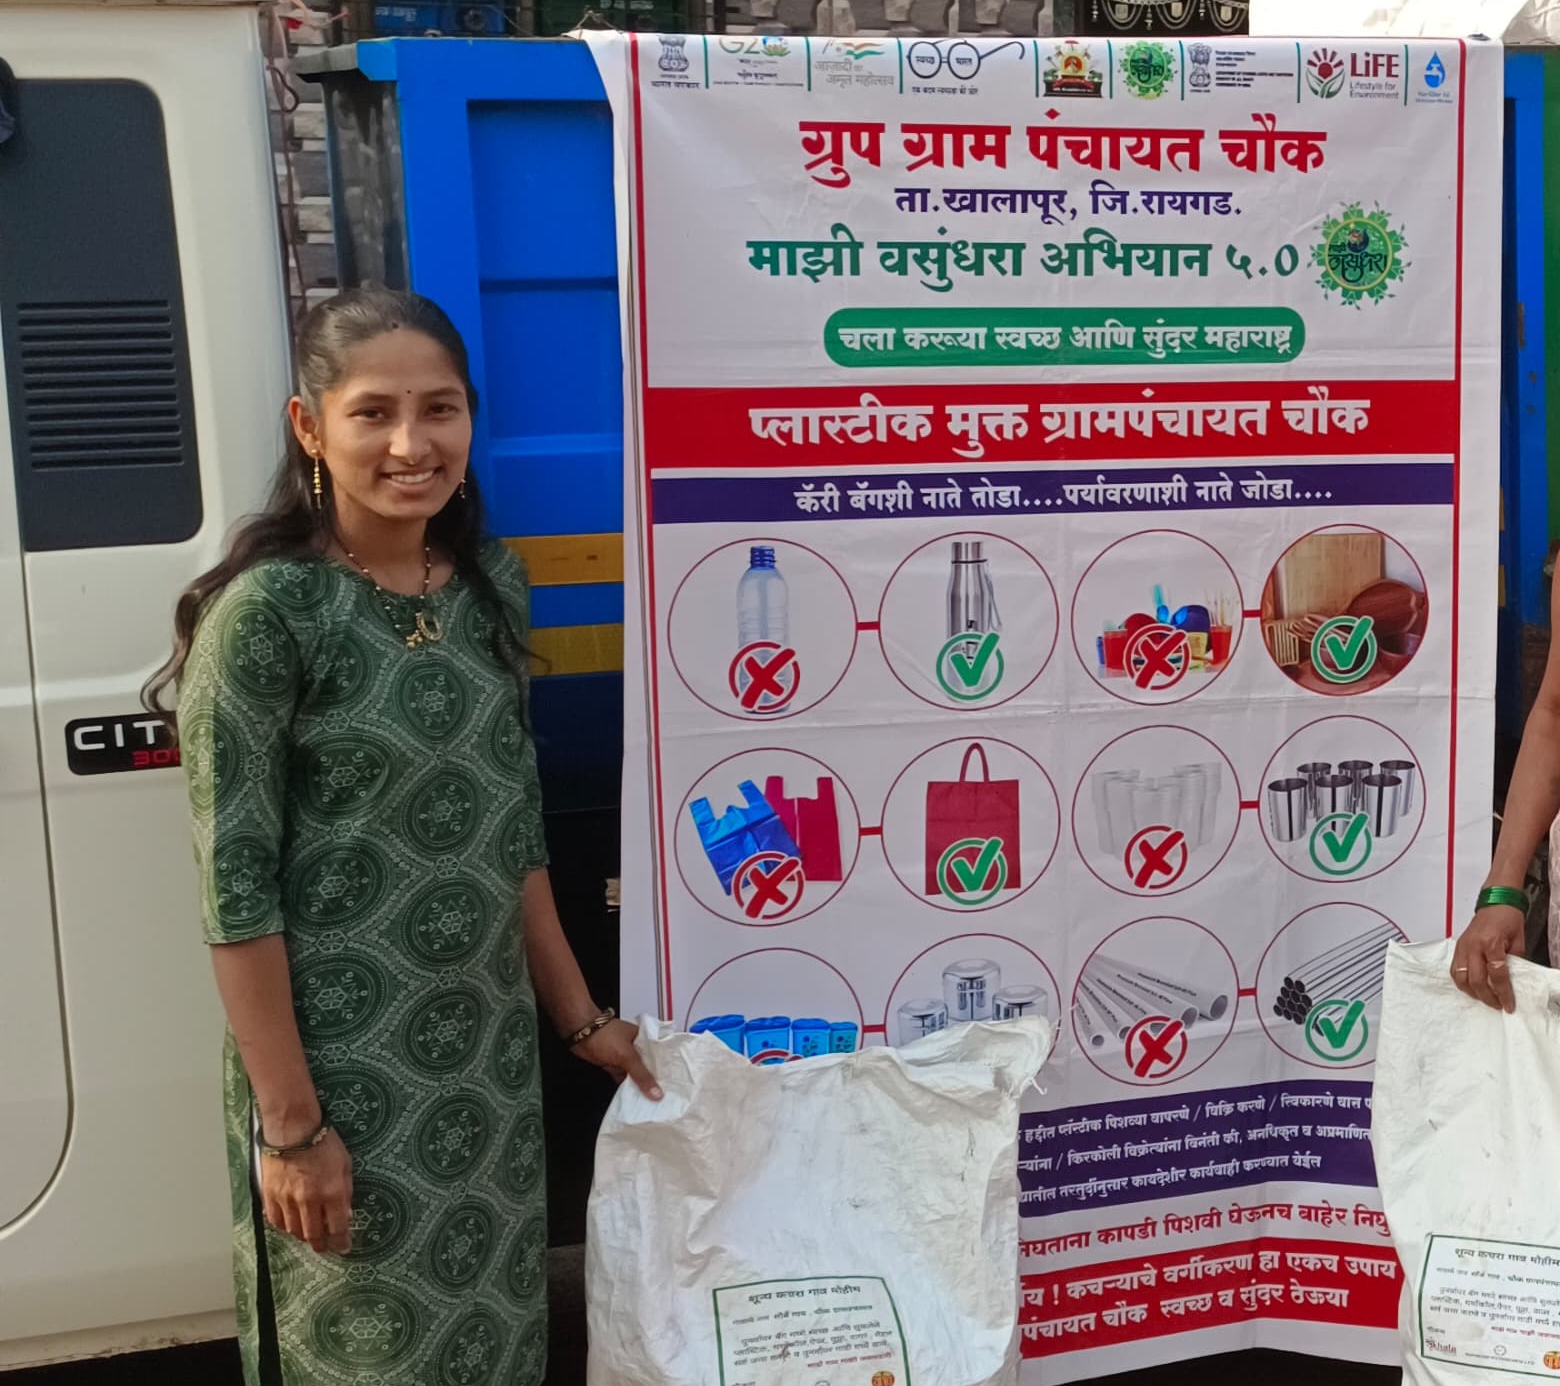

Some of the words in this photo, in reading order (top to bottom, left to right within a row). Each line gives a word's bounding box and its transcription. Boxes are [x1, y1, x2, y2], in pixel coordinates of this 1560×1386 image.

[1350, 51, 1400, 79] LiFE
[798, 121, 886, 189] ग्रुप
[900, 123, 1012, 172] ग्राम
[1025, 108, 1206, 173] पंचायत
[1218, 112, 1328, 174] चौक
[745, 222, 865, 284] माझी
[876, 226, 1027, 293] वसुंधरा
[1040, 227, 1212, 277] अभियान
[838, 327, 897, 351] चला
[994, 326, 1061, 351] स्वच्छ
[1069, 318, 1136, 349] आणि
[1142, 318, 1199, 359] सुंदर
[1203, 326, 1293, 354] महाराष्ट्र
[748, 392, 934, 446] प्लास्टीक
[945, 404, 1029, 459] मुक्त
[1039, 388, 1271, 444] ग्रामपंचायत
[1281, 385, 1371, 435] चौक
[794, 482, 840, 513] कॅरी
[846, 480, 914, 513] बॅगशी
[919, 478, 963, 509] नाते
[1193, 473, 1234, 502] नाते
[132, 749, 180, 766] 30
[1098, 1219, 1157, 1245] कापडी
[1164, 1210, 1222, 1236] पिशवी
[1259, 1251, 1279, 1270] हा
[1287, 1251, 1339, 1272] एकच
[1344, 1256, 1397, 1279] उपाय
[1021, 1312, 1096, 1341] पंचायत
[1102, 1300, 1148, 1326] चौक
[1161, 1292, 1212, 1318] स्वच्छ
[1239, 1278, 1285, 1311] सुंदर
